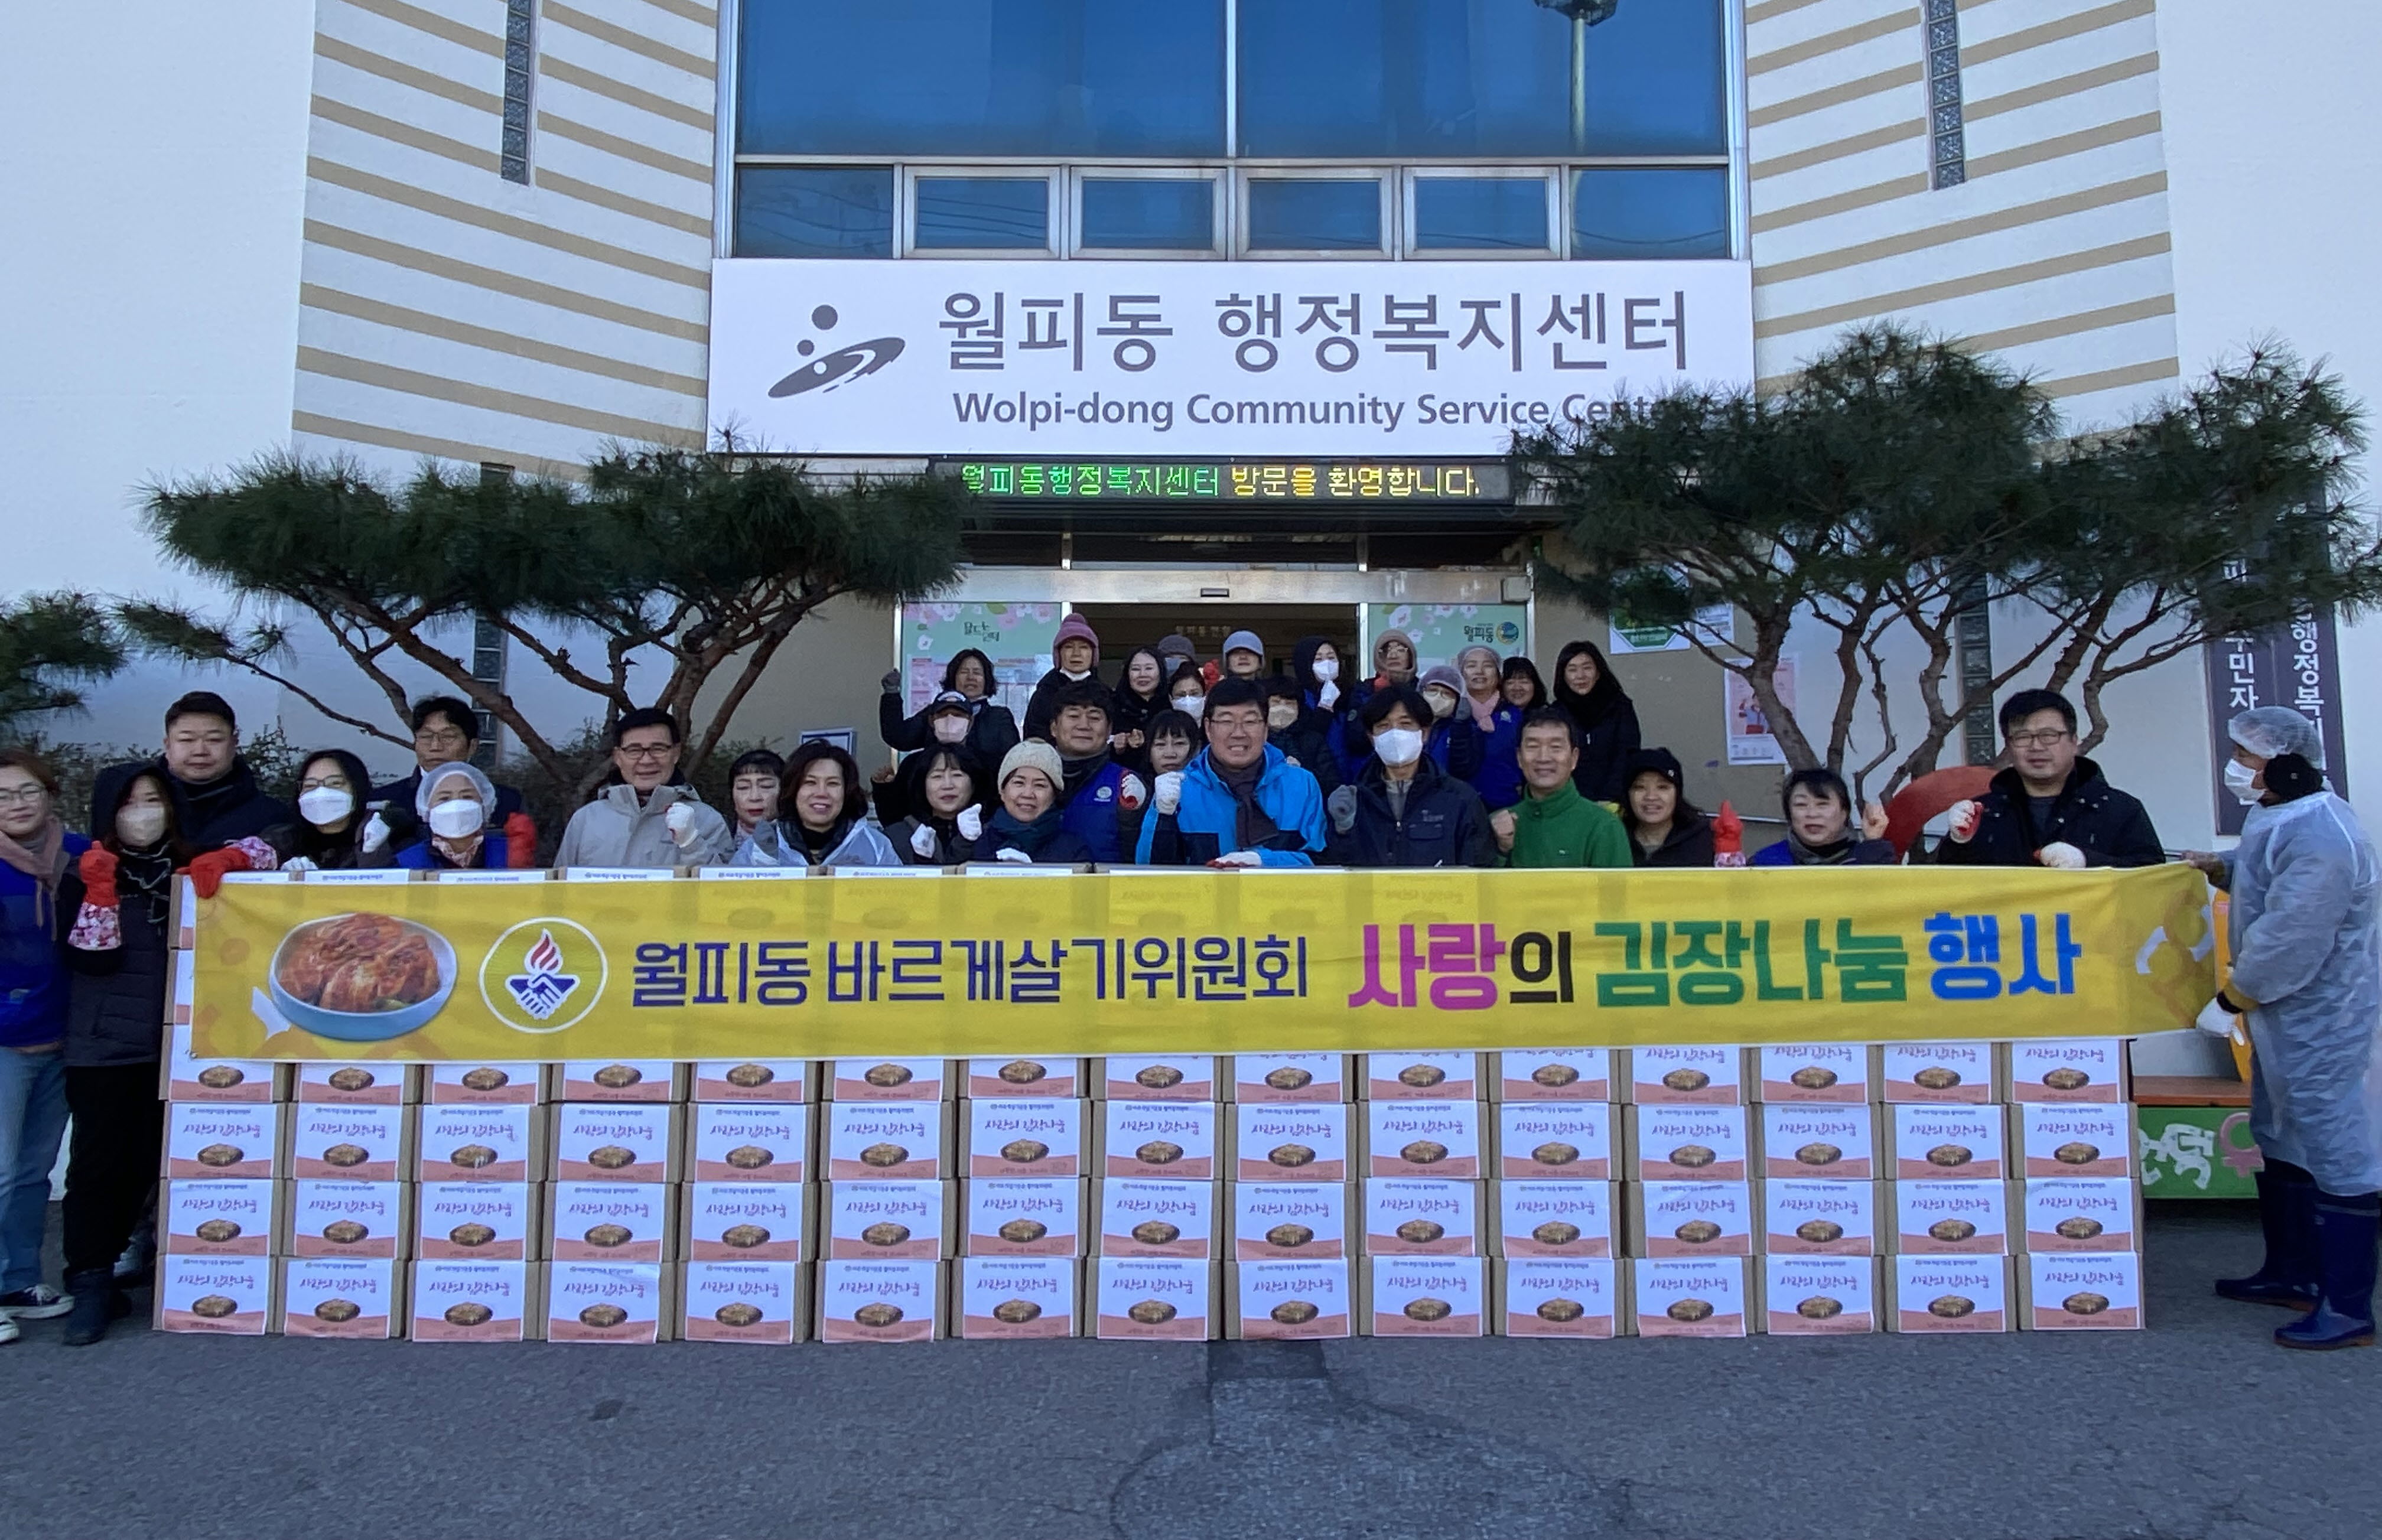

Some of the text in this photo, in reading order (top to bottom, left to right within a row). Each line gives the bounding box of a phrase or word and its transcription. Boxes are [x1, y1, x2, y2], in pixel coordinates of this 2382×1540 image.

[939, 291, 1687, 373] 월피동 행정복지센터
[952, 391, 1173, 432] Wolpi-dong
[1187, 393, 1405, 433] Community
[1417, 392, 1550, 425] Service
[962, 464, 1480, 497] 월피동행정복지센터 방문을 환영합니다.
[633, 912, 2082, 1011] 월피동 바르게살기위원회 사랑의 김장나눔 행사
